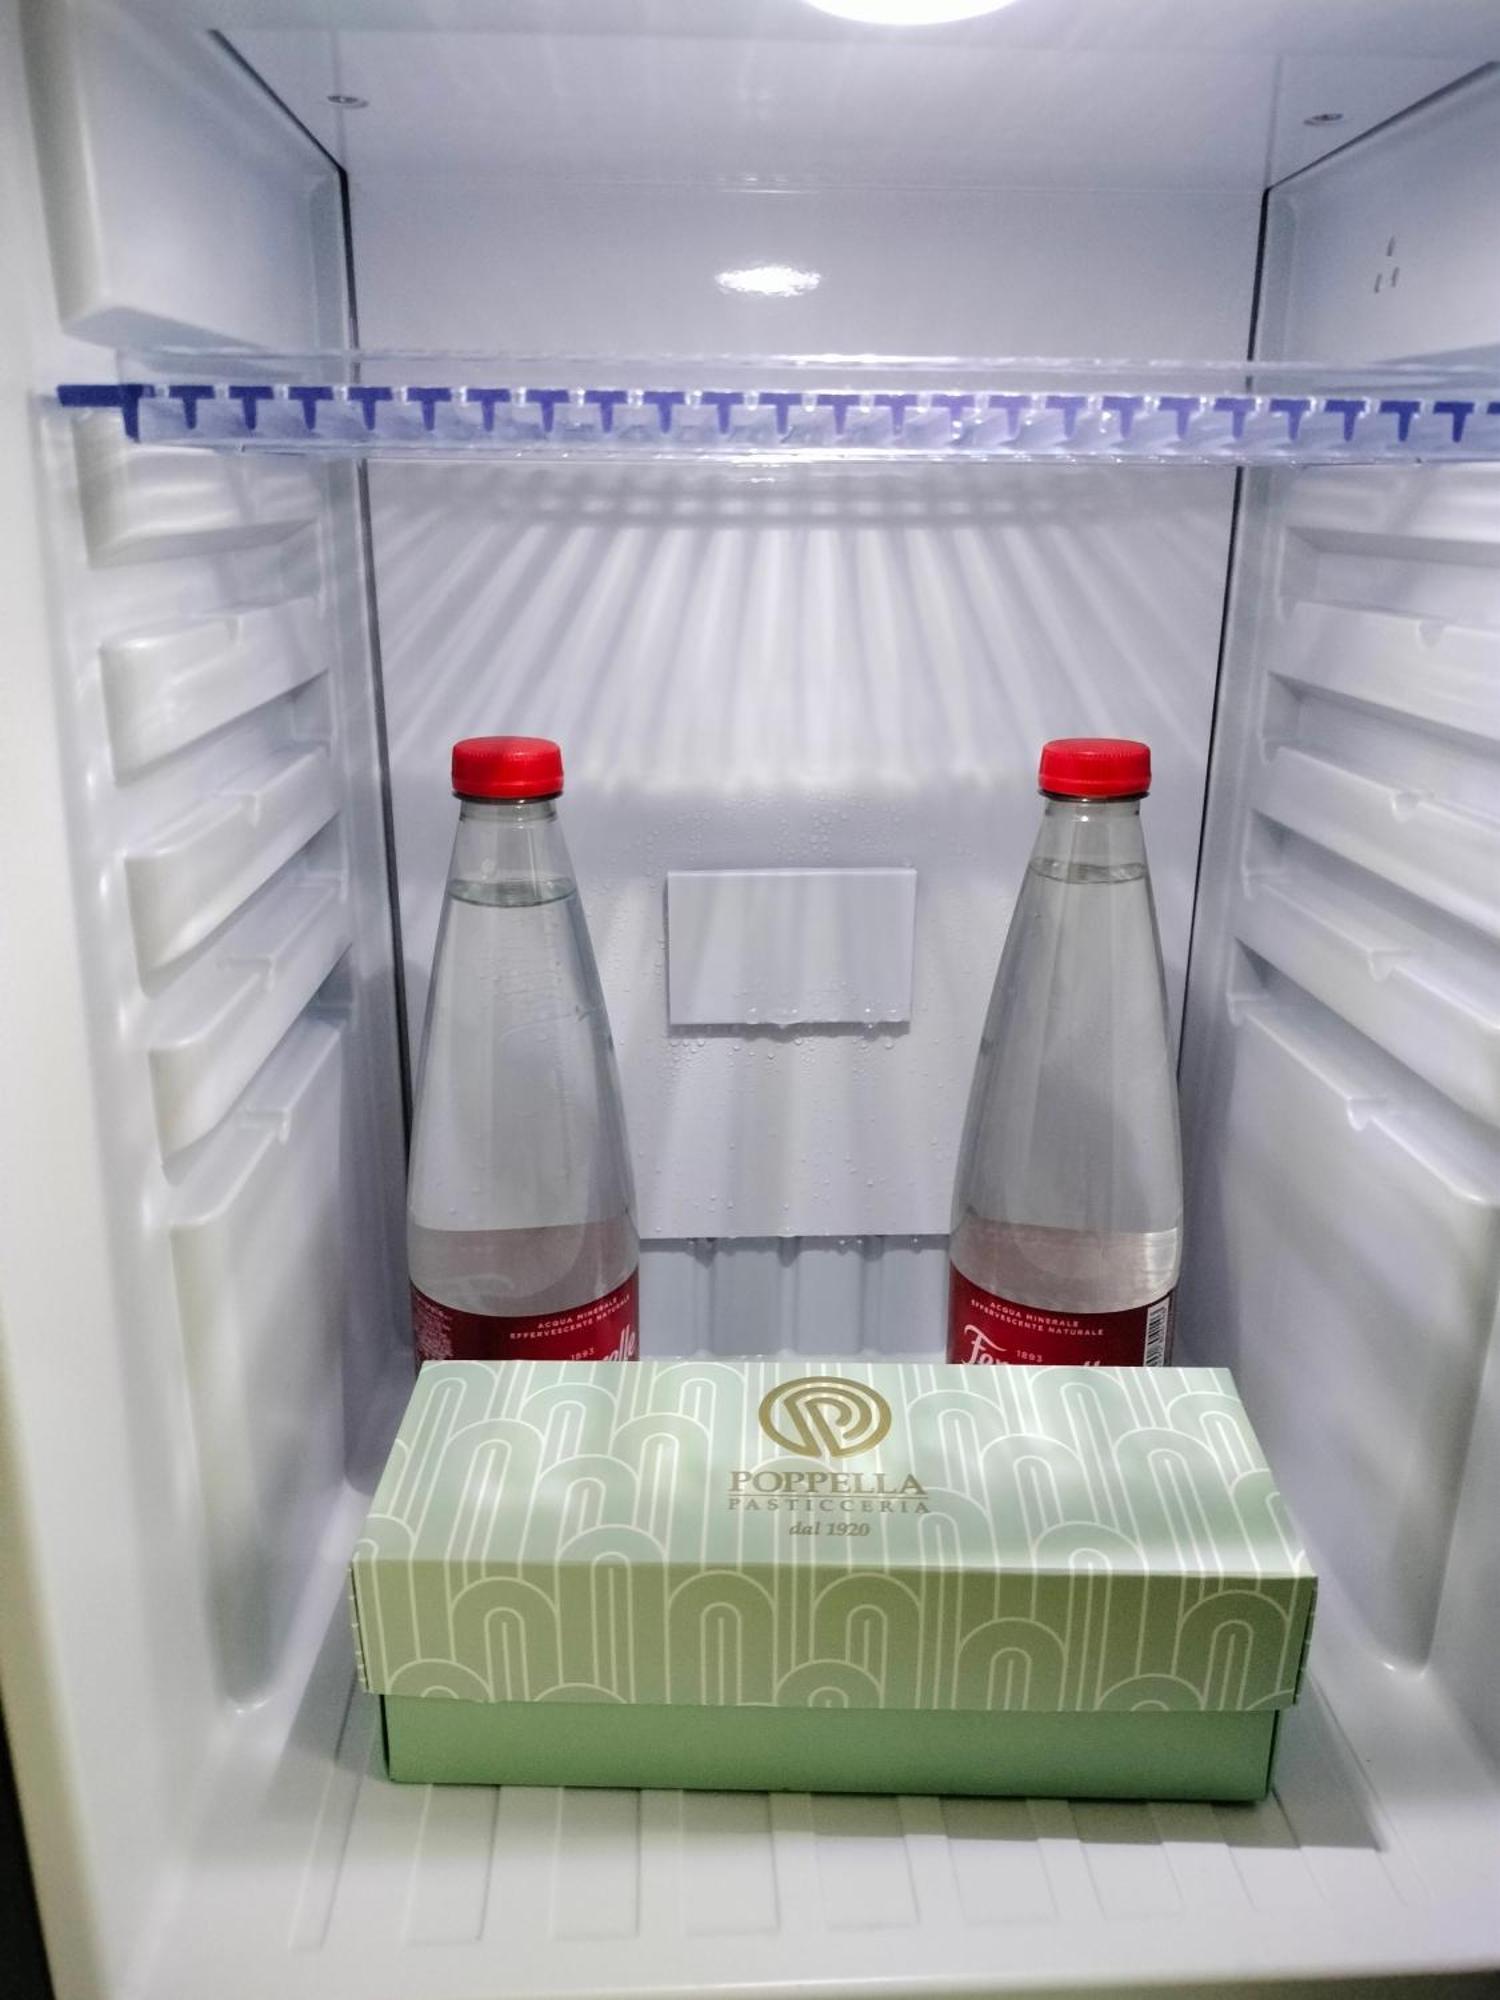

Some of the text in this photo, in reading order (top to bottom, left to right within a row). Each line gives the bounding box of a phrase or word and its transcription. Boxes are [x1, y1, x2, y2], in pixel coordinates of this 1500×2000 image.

[509, 1294, 631, 1340] EFFERVESCENTE NATURALE
[537, 1297, 618, 1329] ACQUA MINERALE
[970, 1298, 1105, 1337] EFFERVESCENTE NATURALE
[990, 1301, 1080, 1328] ACQUA MINERALE
[727, 1470, 927, 1496] POPPELLA
[727, 1498, 930, 1514] PASTICCERIA
[788, 1520, 871, 1538] dal 1920
